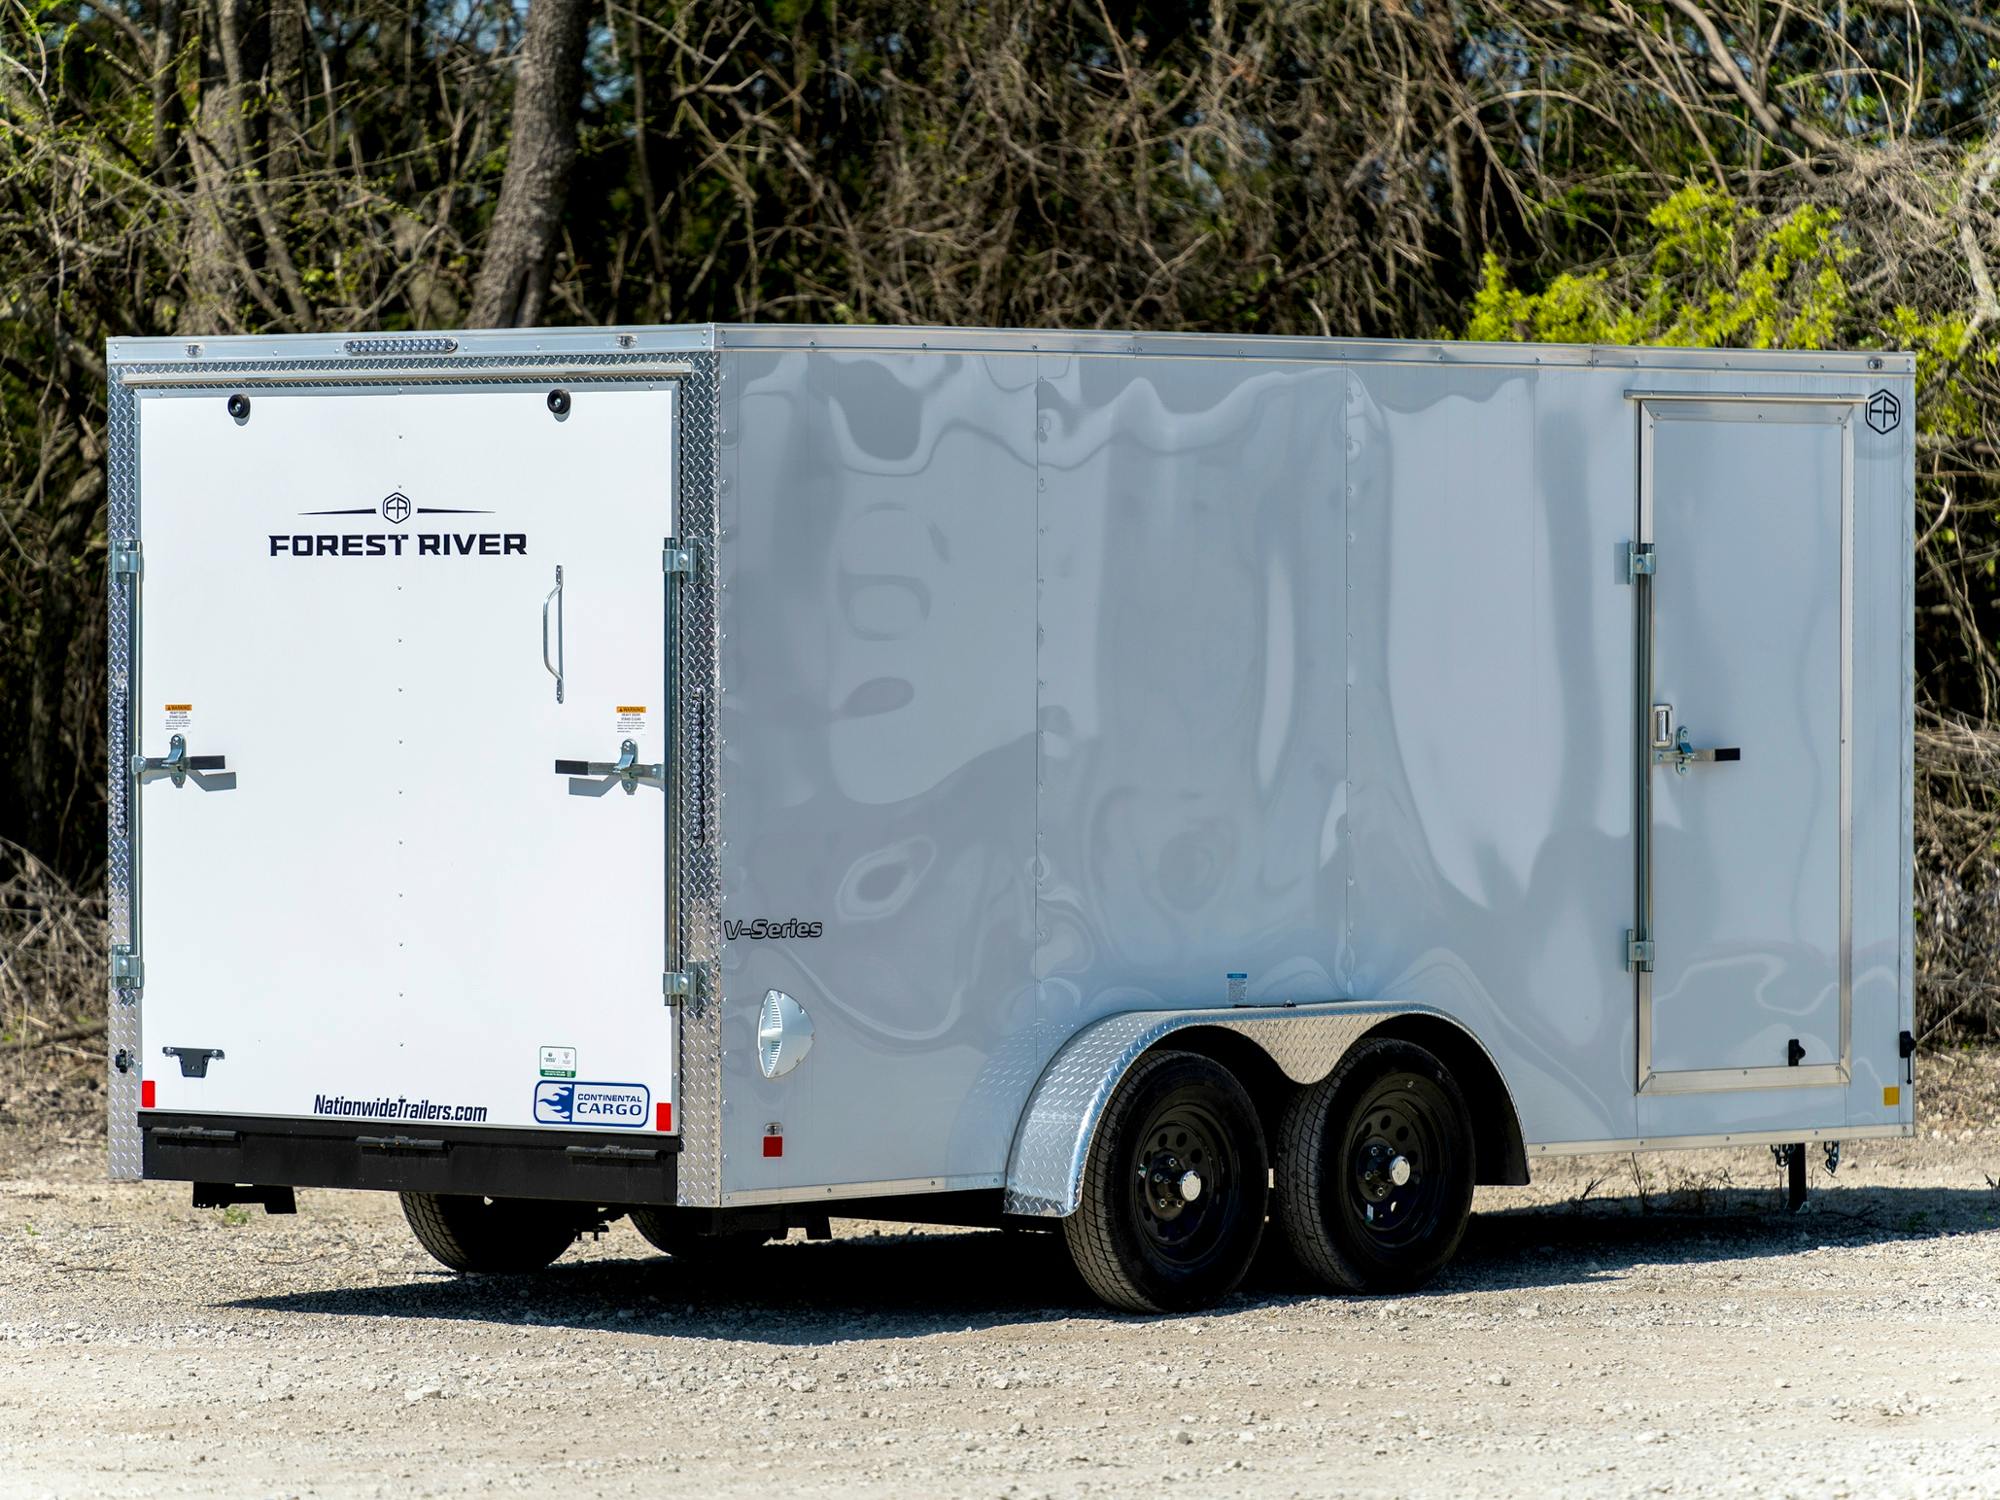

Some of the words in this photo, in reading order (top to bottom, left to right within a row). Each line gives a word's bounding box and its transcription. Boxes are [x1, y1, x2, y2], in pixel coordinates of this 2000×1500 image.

[268, 534, 408, 556] FOREST
[417, 533, 528, 555] RIVER
[724, 917, 823, 940] V-Series
[314, 1094, 488, 1122] NationwideTrailers.com
[576, 1102, 642, 1116] CARGO
[577, 1093, 642, 1103] CONTINENTAL
